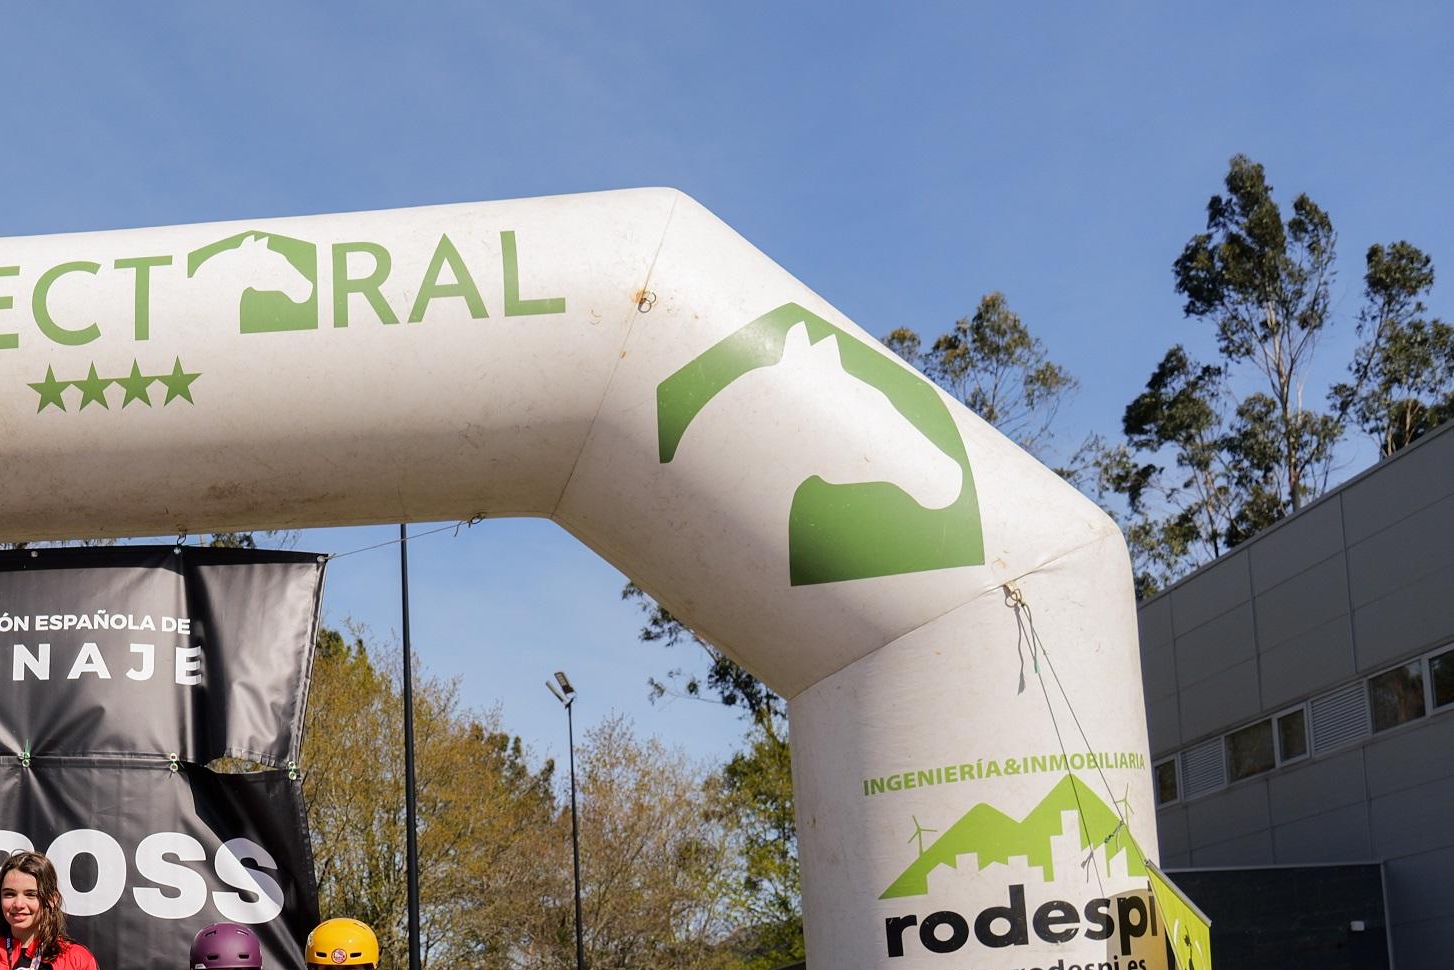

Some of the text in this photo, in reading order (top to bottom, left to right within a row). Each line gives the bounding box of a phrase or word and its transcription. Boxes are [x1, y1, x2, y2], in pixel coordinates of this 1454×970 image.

[34, 608, 156, 632] ESPAÑOLA
[160, 617, 191, 635] DE
[863, 752, 1146, 796] INGENIERÍA&INMOBILIARIA
[885, 881, 1157, 958] rodespi
